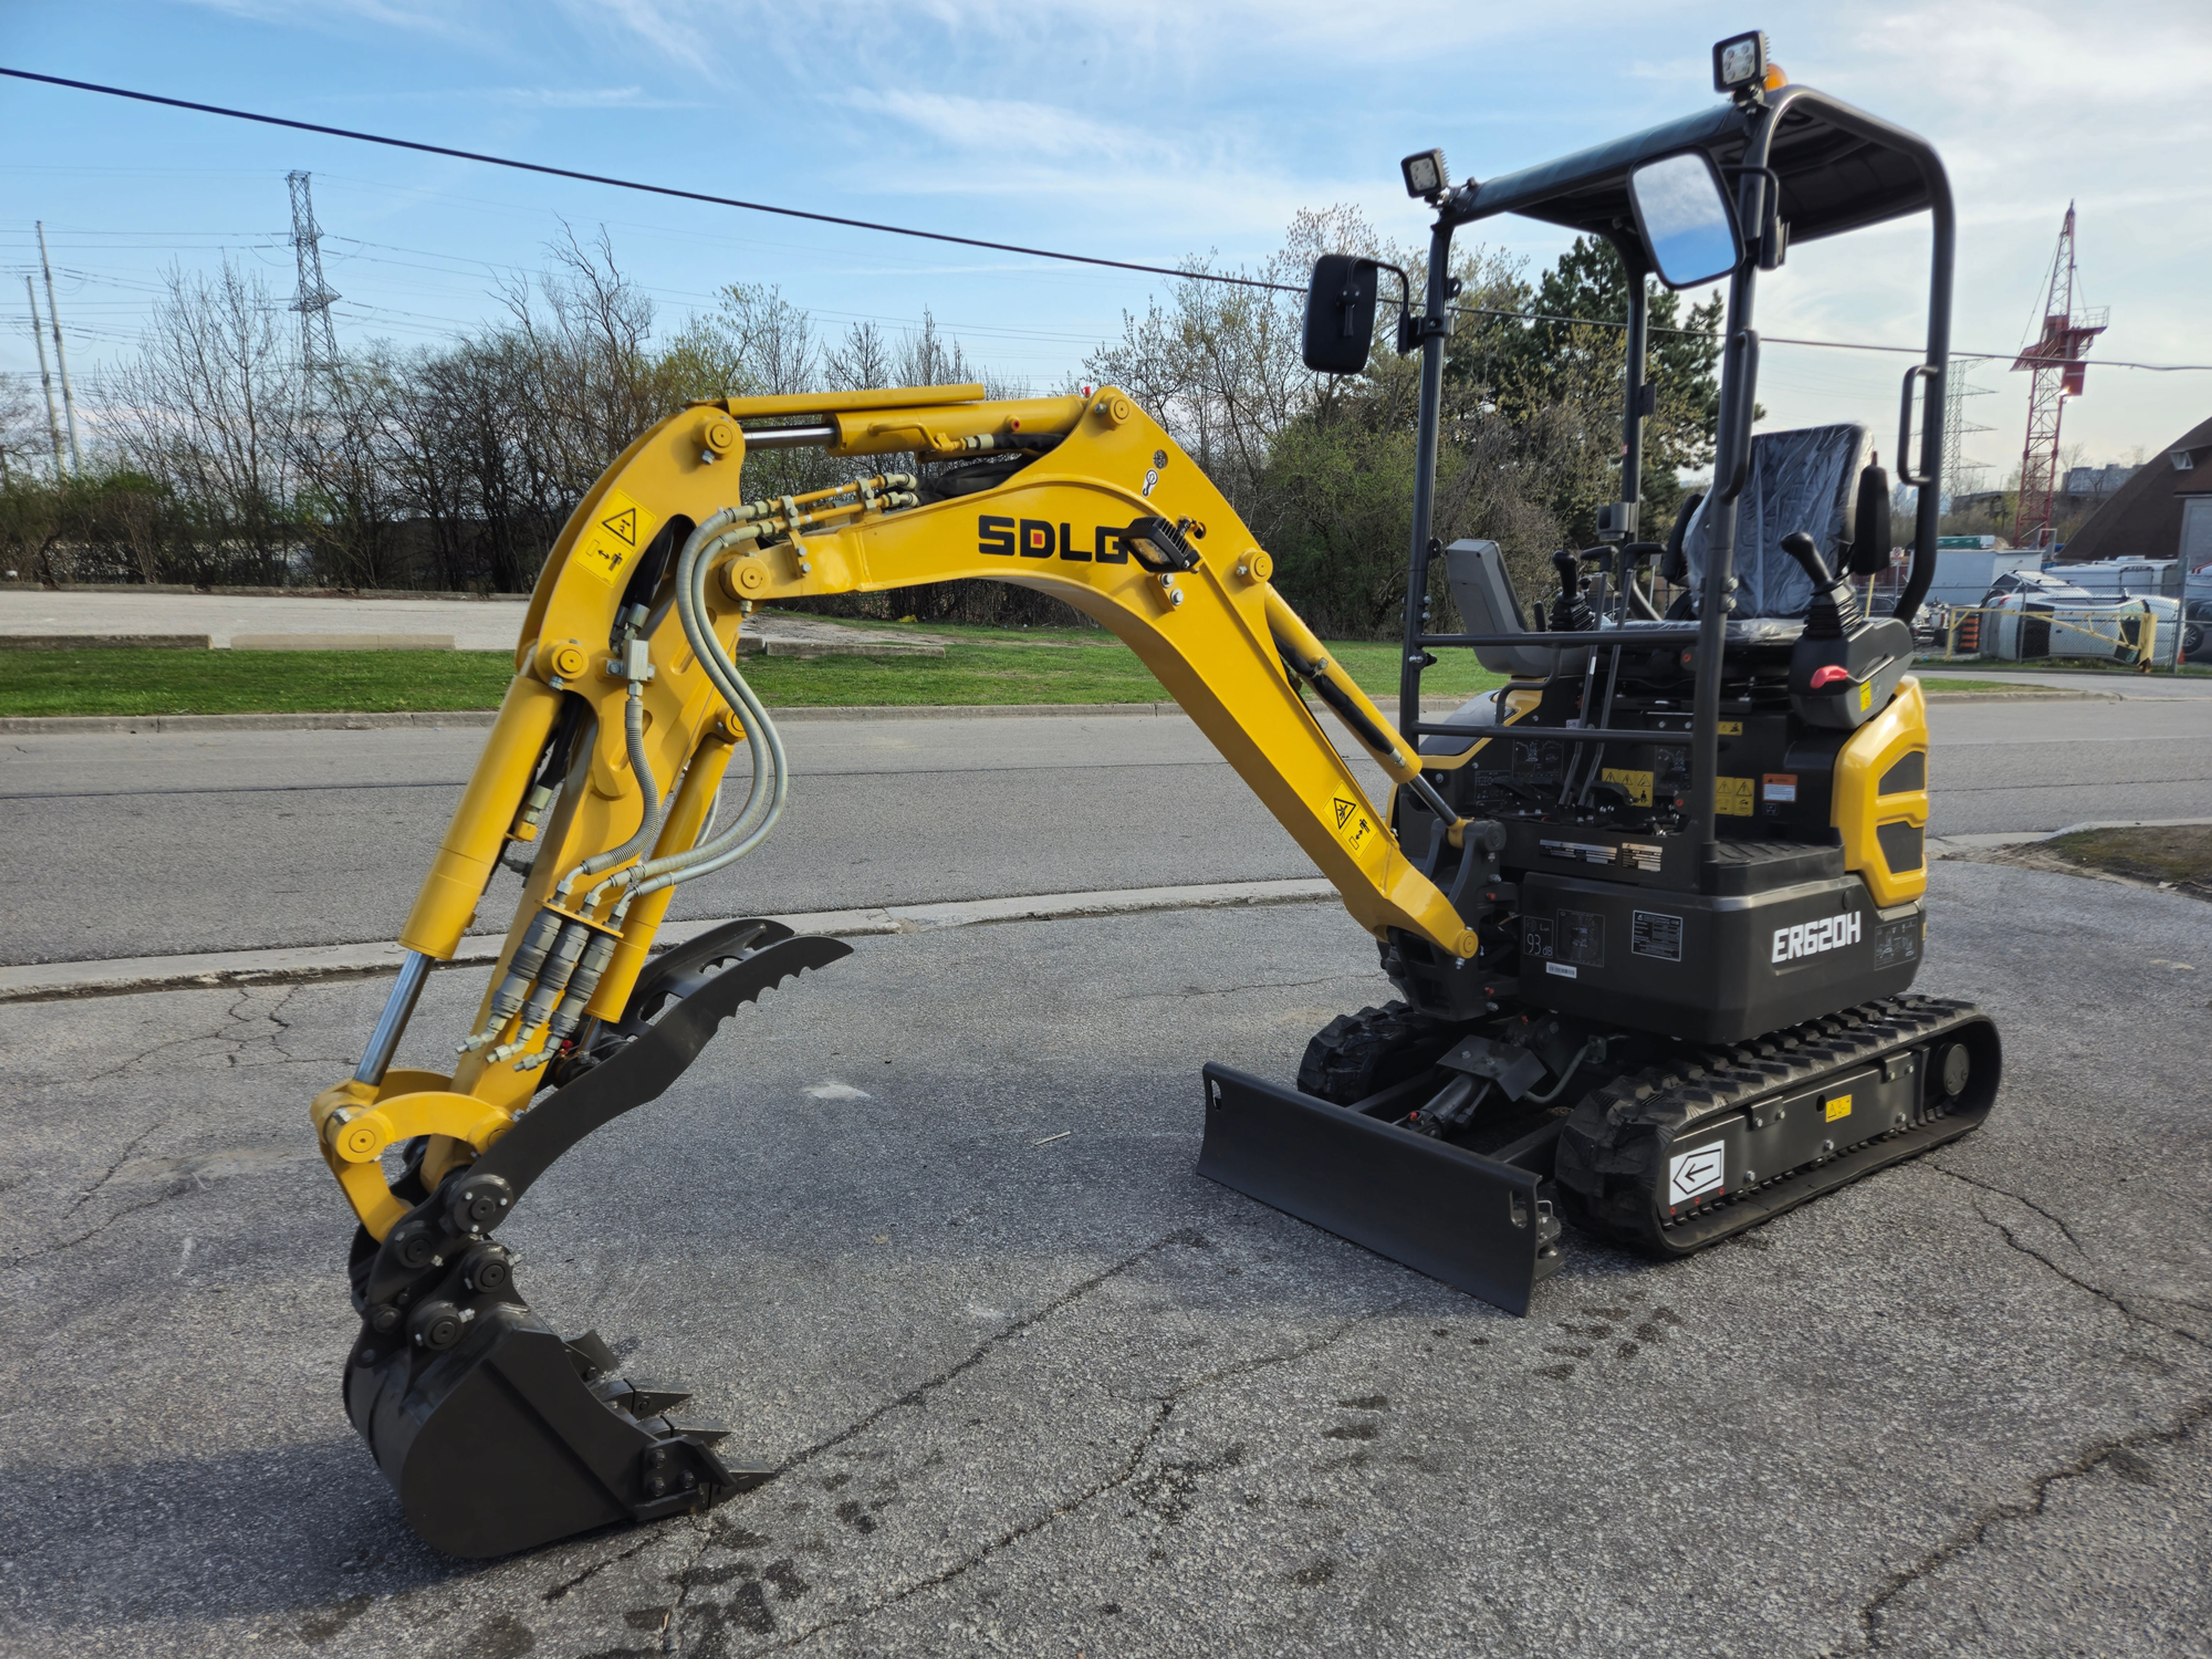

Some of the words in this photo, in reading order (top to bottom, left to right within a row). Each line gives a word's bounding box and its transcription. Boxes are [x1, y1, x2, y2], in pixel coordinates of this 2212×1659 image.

[978, 514, 1128, 565] SDLG
[1527, 933, 1541, 955] 93
[1542, 945, 1553, 956] dB
[1772, 911, 1861, 963] ER620H
